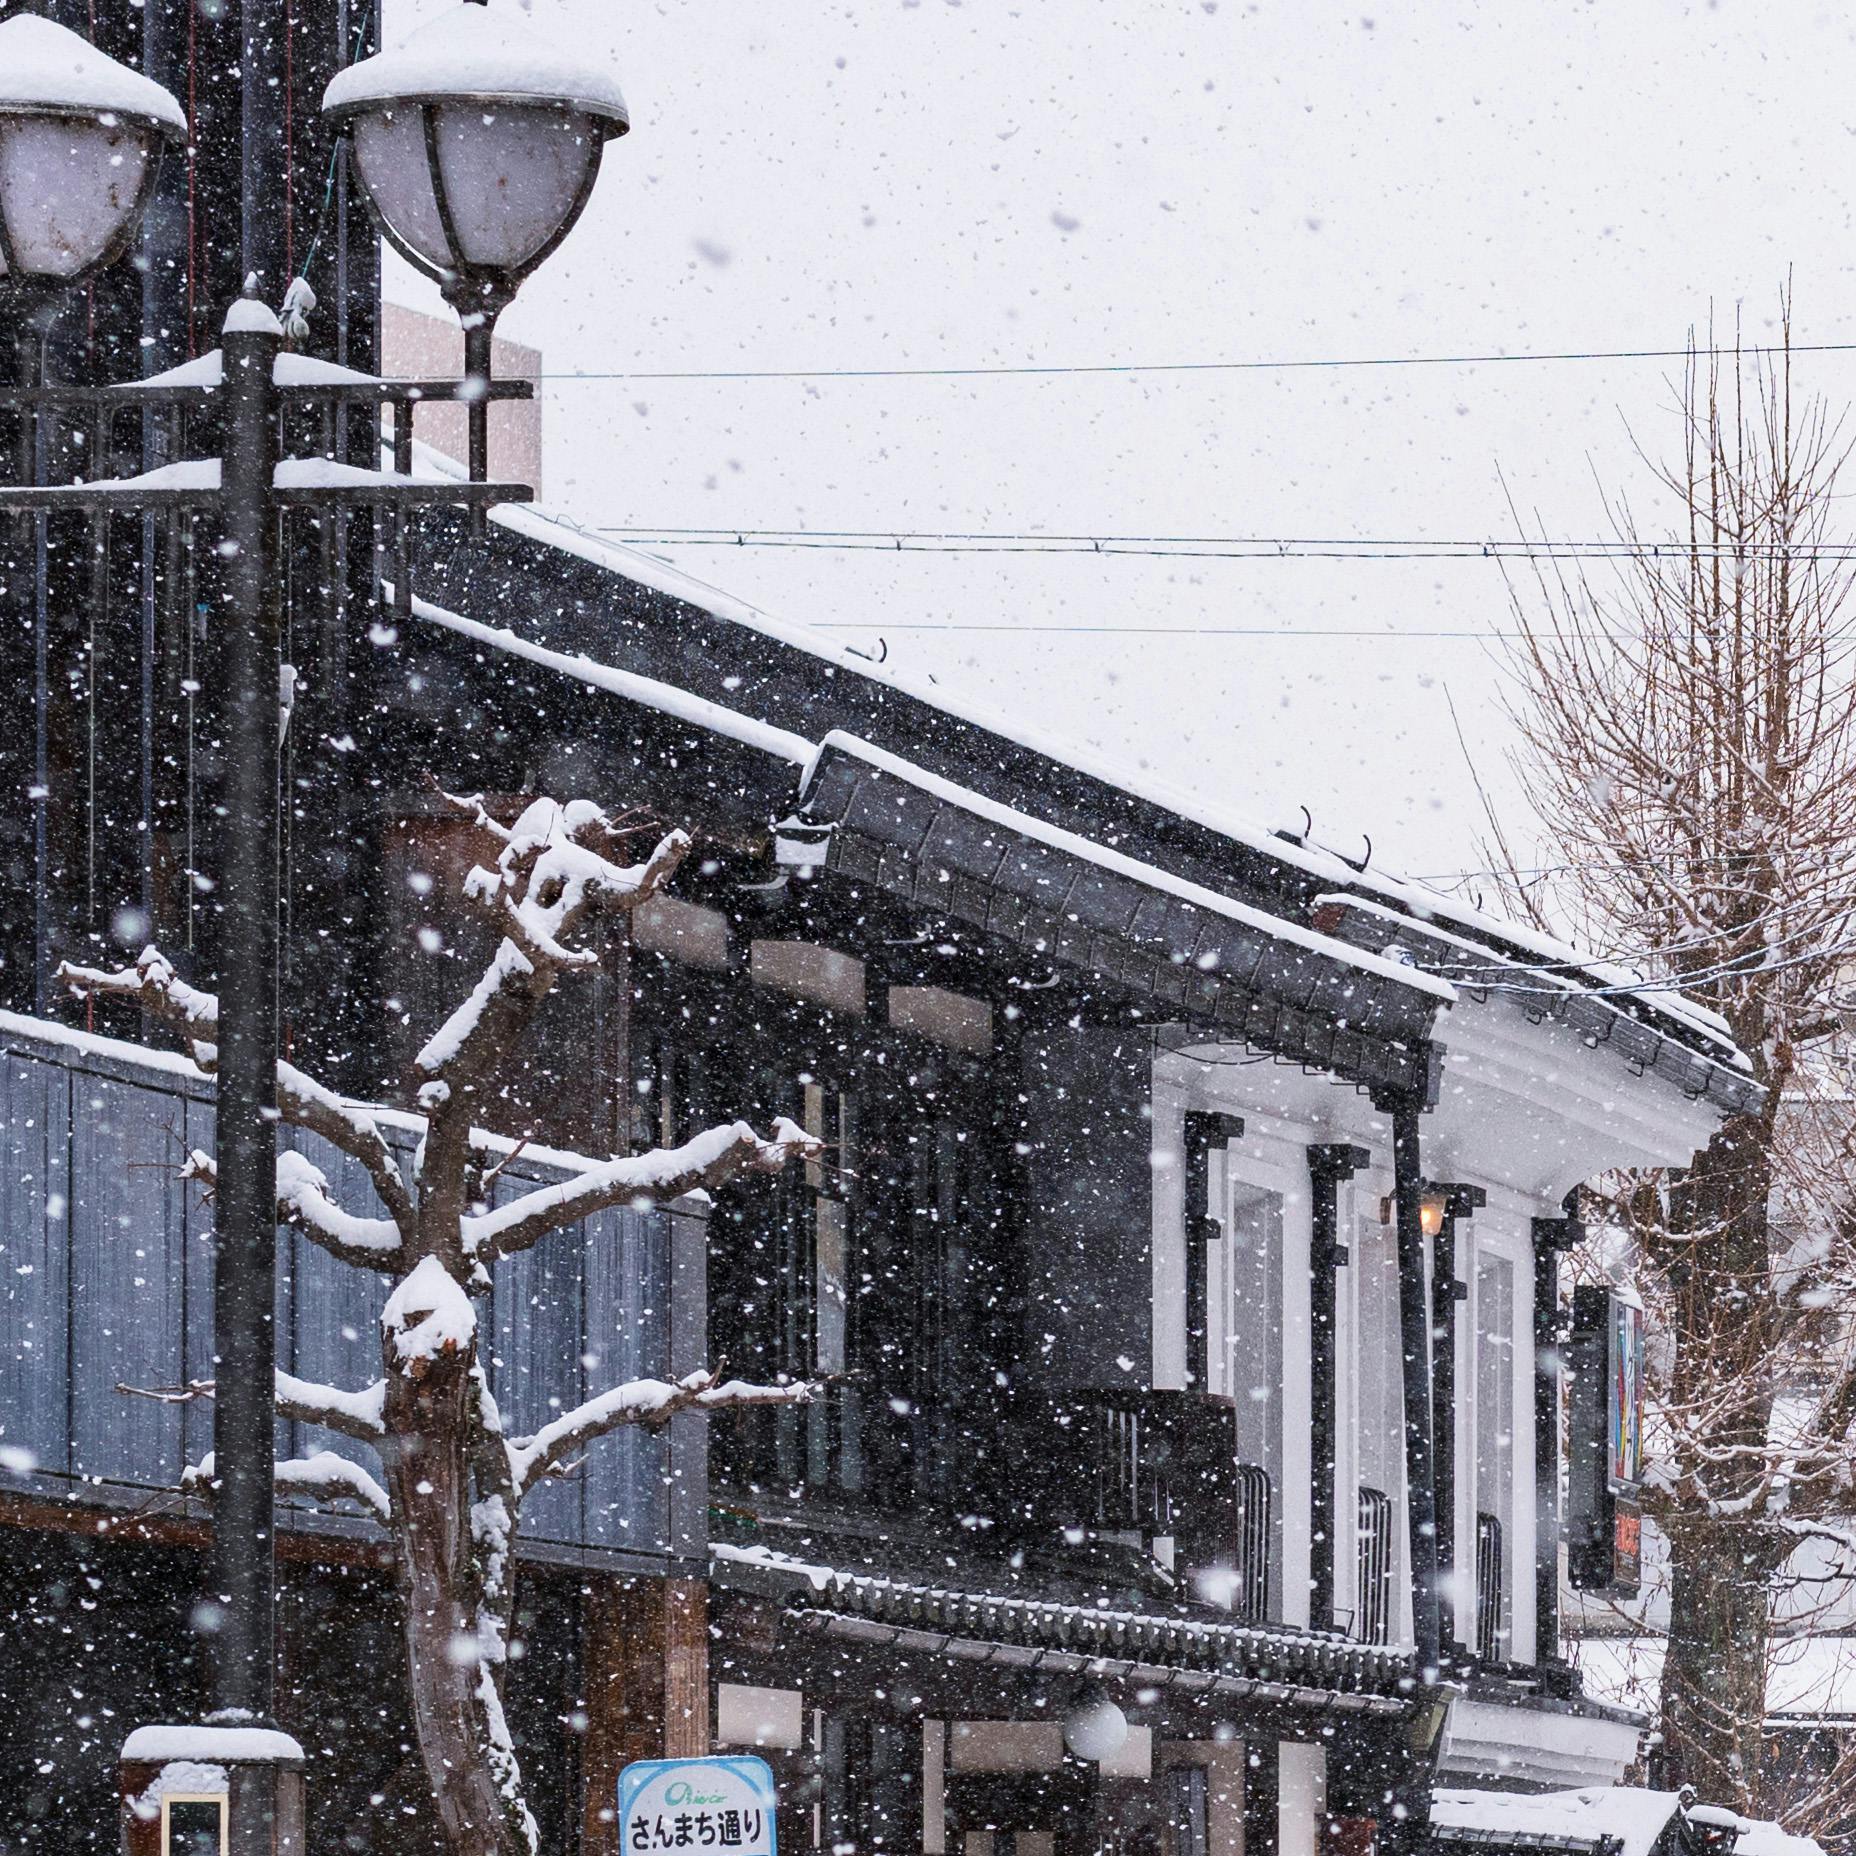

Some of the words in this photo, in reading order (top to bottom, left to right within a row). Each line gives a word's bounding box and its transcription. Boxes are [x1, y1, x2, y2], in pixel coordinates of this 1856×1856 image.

[631, 1809, 761, 1850] さんまち通り
